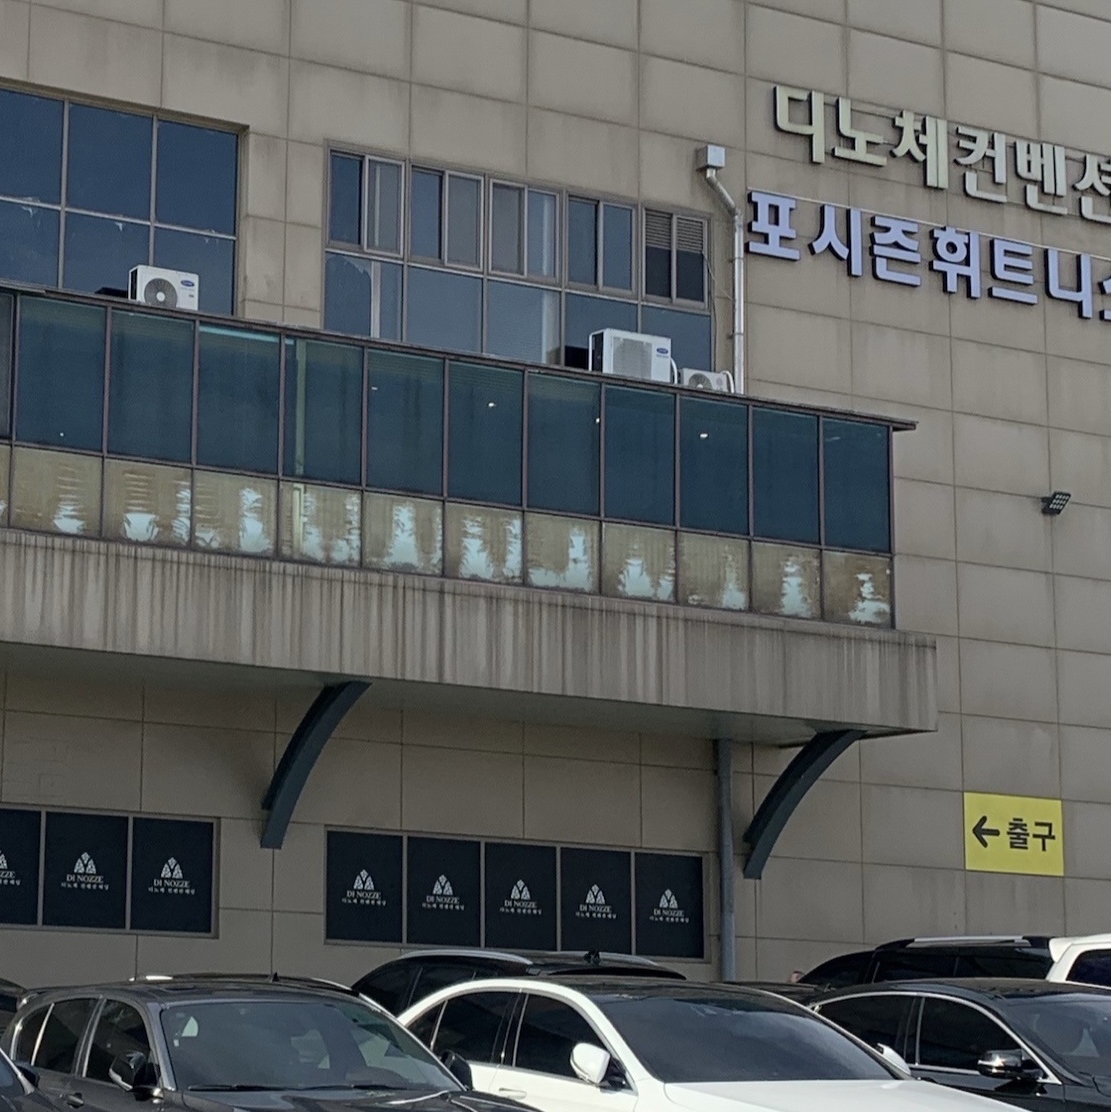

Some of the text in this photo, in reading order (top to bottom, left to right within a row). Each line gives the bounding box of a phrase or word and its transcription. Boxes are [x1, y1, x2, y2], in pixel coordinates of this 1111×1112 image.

[1006, 817, 1056, 852] 출구
[66, 874, 104, 883] DI NOZZE
[164, 879, 190, 888] NOZZE
[346, 890, 381, 899] DI NOZZE
[436, 896, 460, 904] NOZZE
[513, 900, 538, 909] NOZZE
[589, 905, 612, 913] NOZZE
[662, 909, 685, 917] NOZZE
